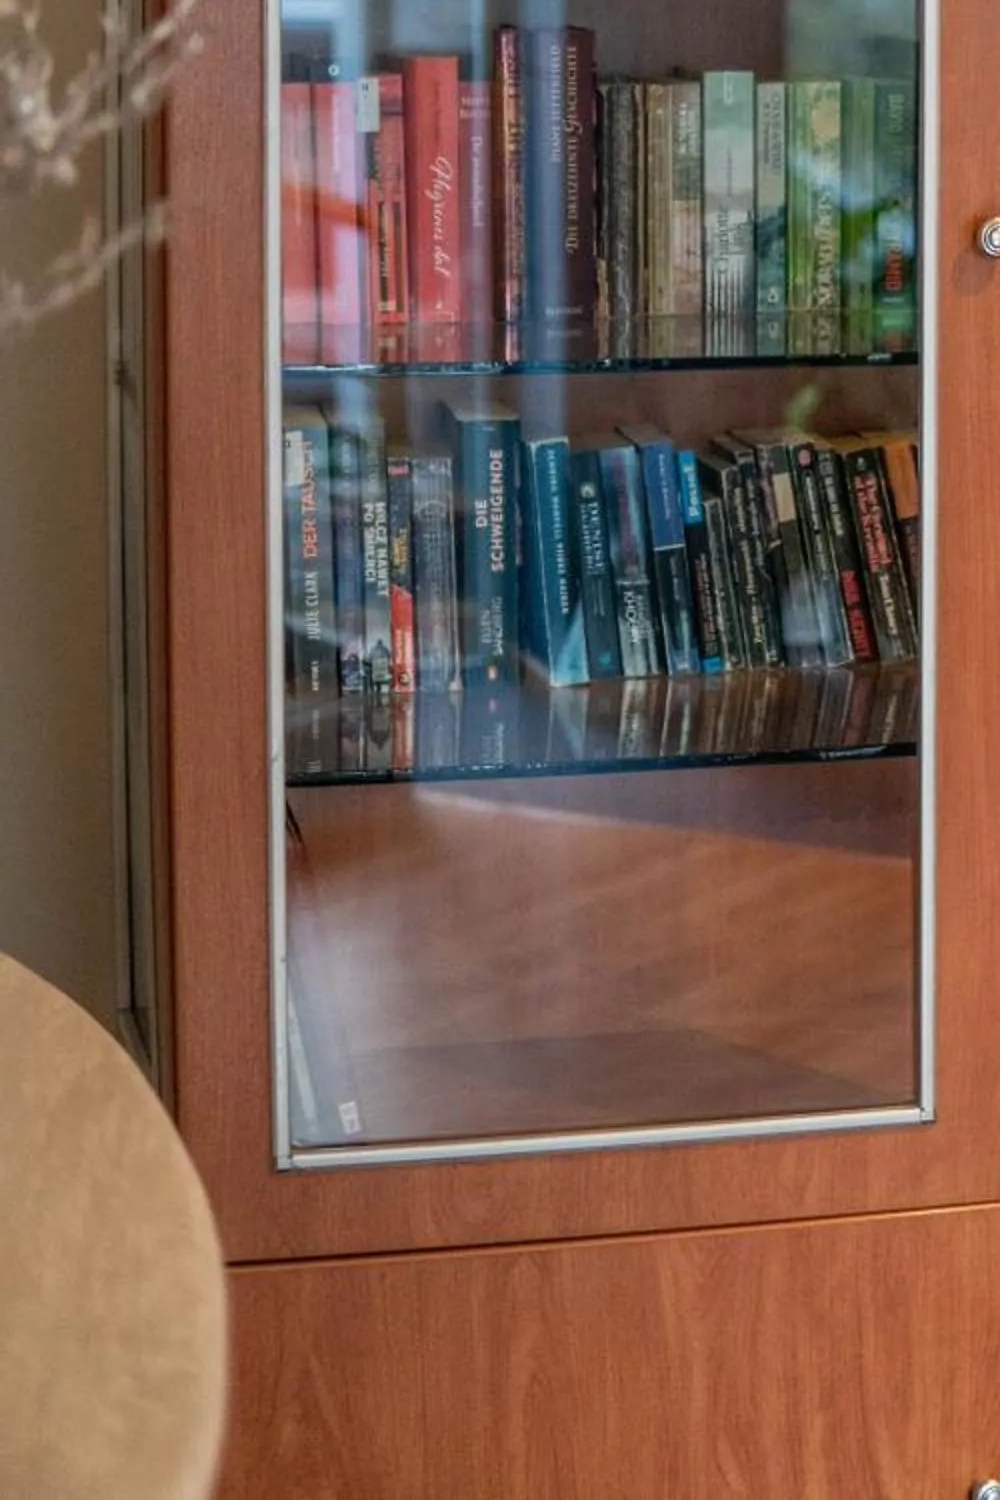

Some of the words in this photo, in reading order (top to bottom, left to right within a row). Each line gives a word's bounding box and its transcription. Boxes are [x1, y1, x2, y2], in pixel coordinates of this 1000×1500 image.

[475, 499, 488, 529] DIE
[489, 449, 505, 573] SCHWEIGENDE
[302, 516, 319, 560] DER
[306, 570, 320, 606] CLARK
[306, 607, 320, 642] JULIE
